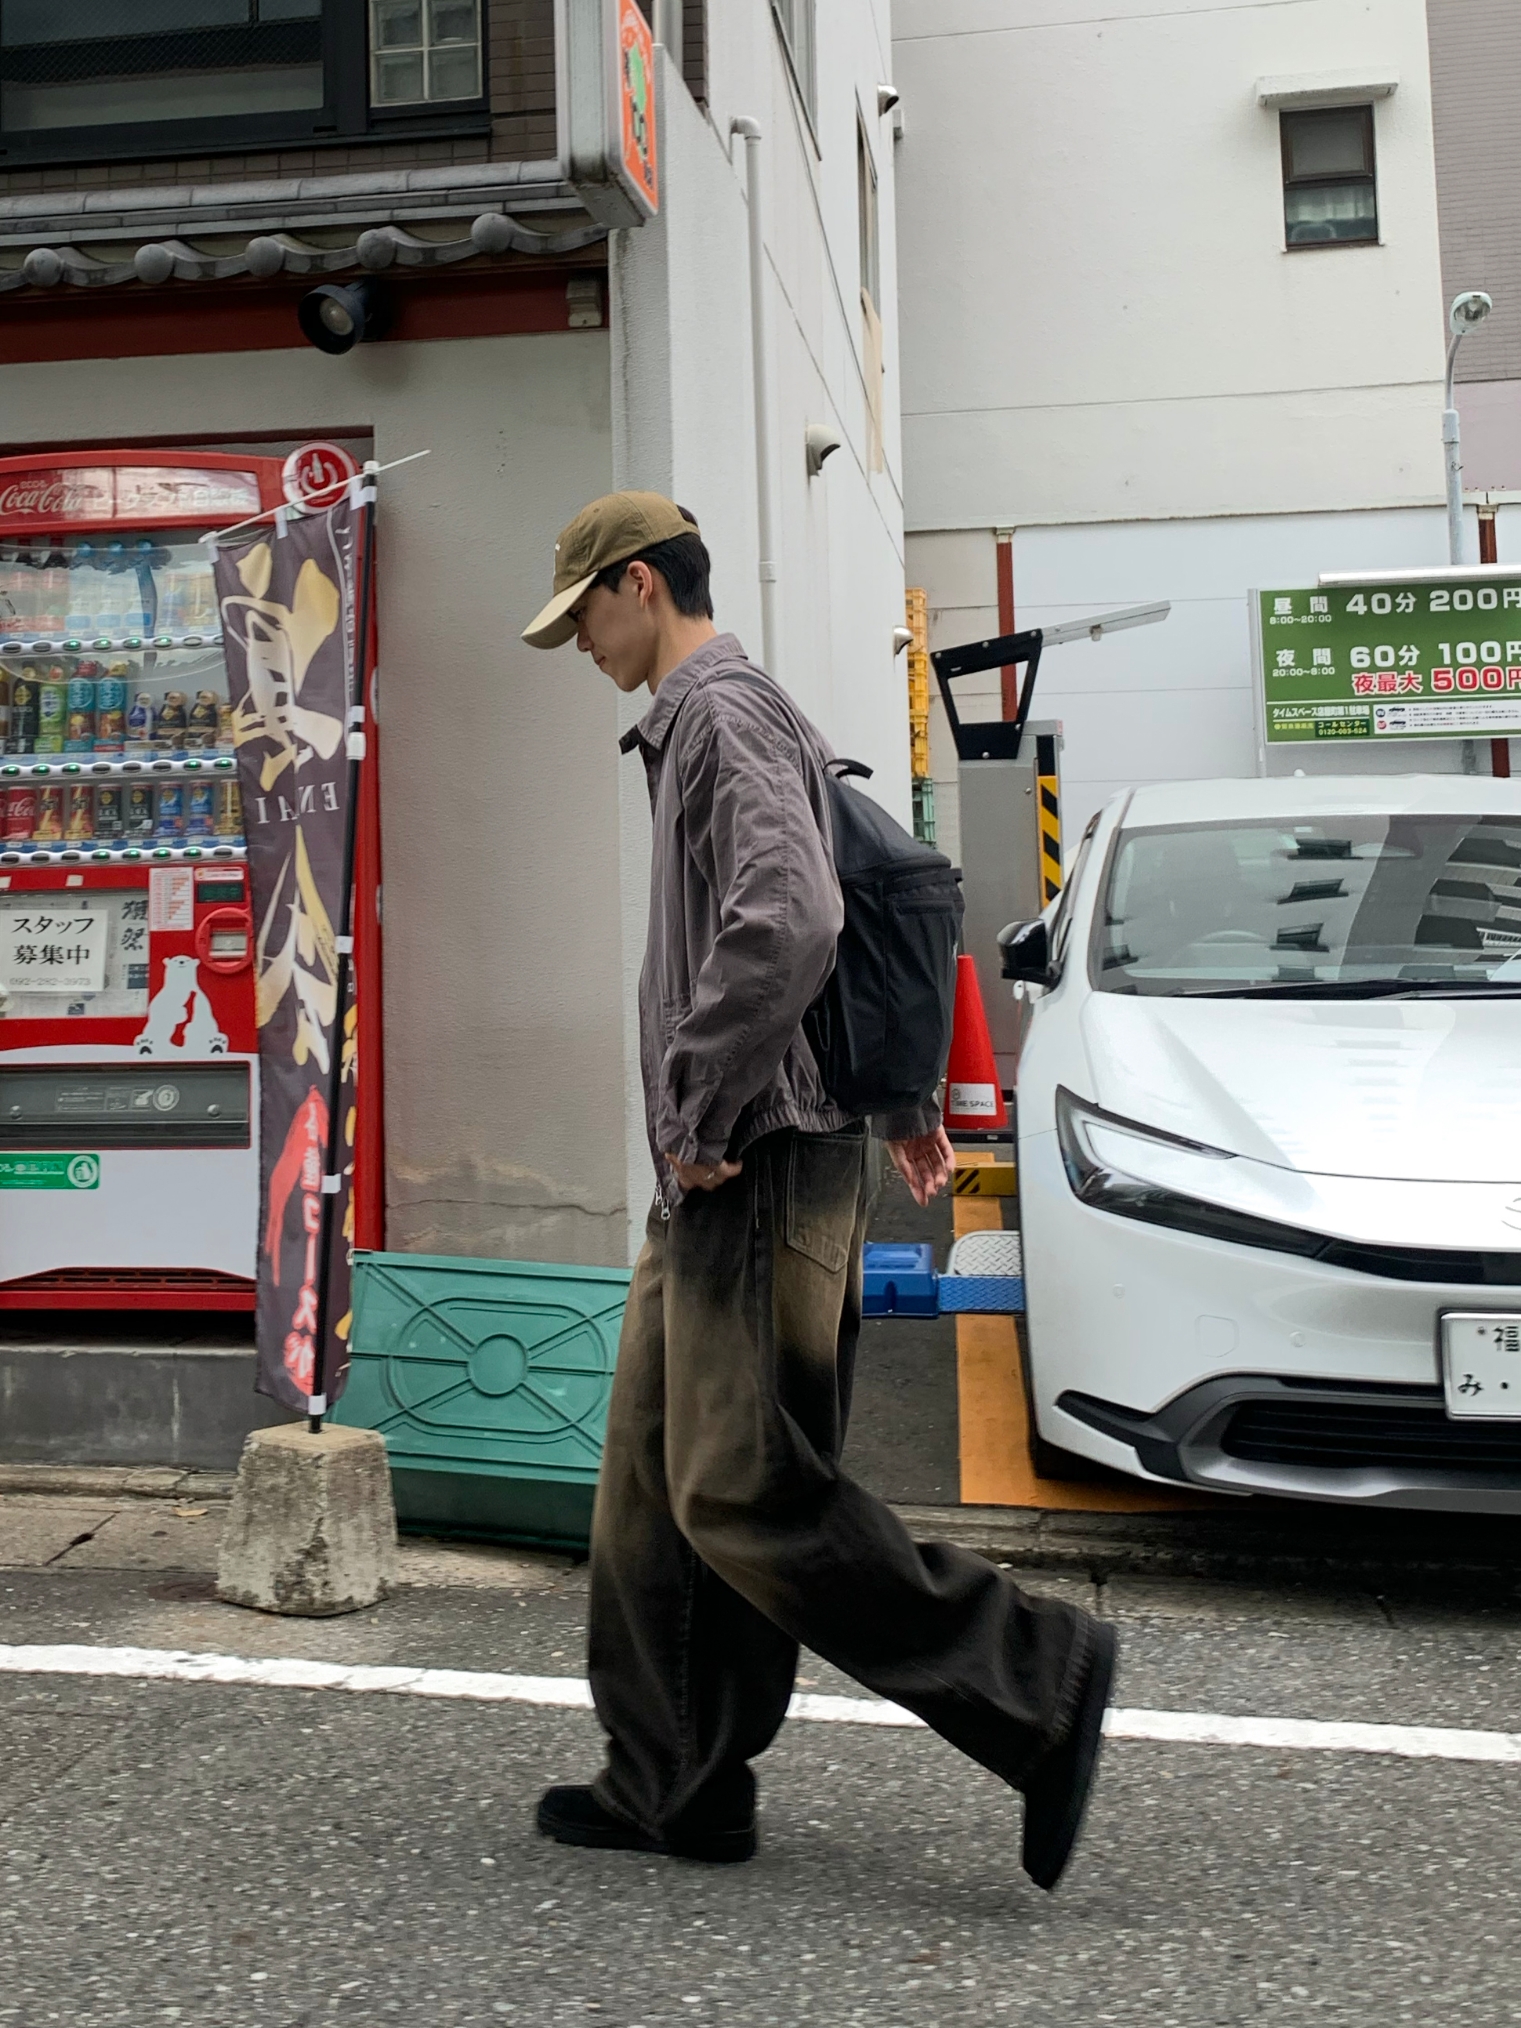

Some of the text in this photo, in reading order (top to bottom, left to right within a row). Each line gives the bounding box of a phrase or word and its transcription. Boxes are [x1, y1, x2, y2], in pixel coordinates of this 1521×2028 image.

[1346, 592, 1418, 615] 40分
[1429, 588, 1521, 612] 200円
[1276, 641, 1521, 668] 夜間 60分 100円
[1352, 670, 1423, 695] 夜最大
[1318, 720, 1367, 728] コールセンター
[11, 916, 94, 935] スタッフ
[13, 944, 90, 965] 募集中
[1458, 1374, 1484, 1396] み
